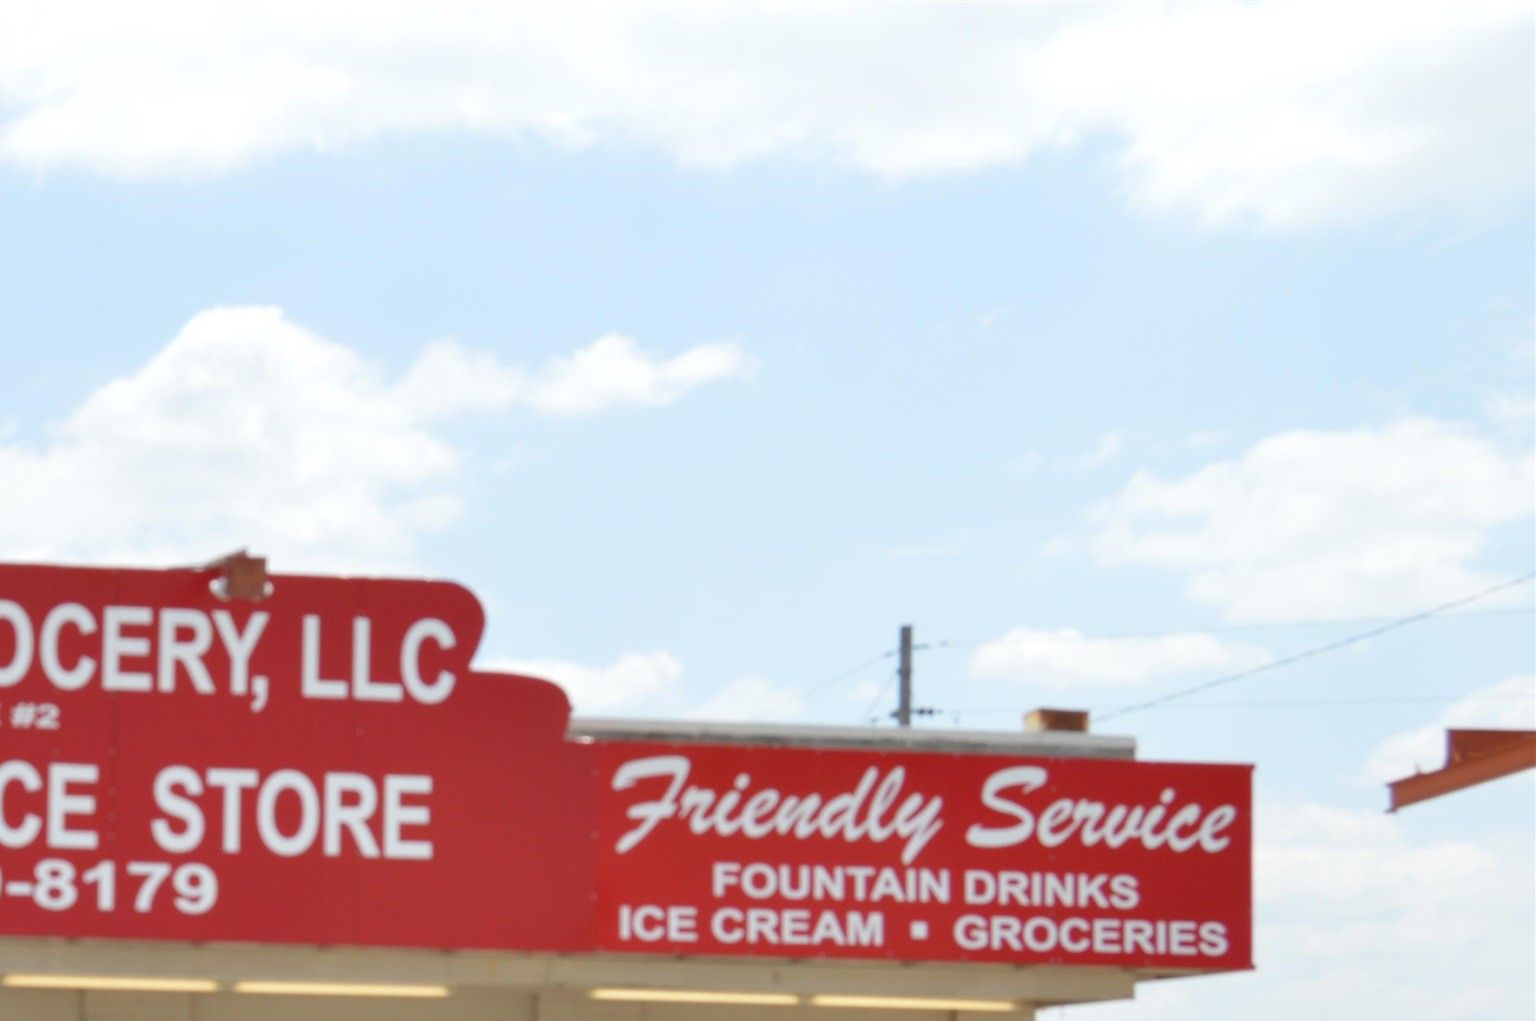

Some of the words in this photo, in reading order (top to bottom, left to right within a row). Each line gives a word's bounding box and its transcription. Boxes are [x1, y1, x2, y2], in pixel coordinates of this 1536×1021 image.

[301, 614, 456, 705] LLC
[10, 702, 60, 730] #2
[150, 764, 434, 861] STORE
[611, 755, 943, 866] Friendly
[965, 765, 1236, 853] Service
[712, 862, 951, 904] FOUNTAIN
[964, 869, 1140, 910] DRINKS
[618, 904, 698, 943] ICE
[710, 907, 884, 947] CREAM
[953, 914, 1229, 957] GROCERIES
